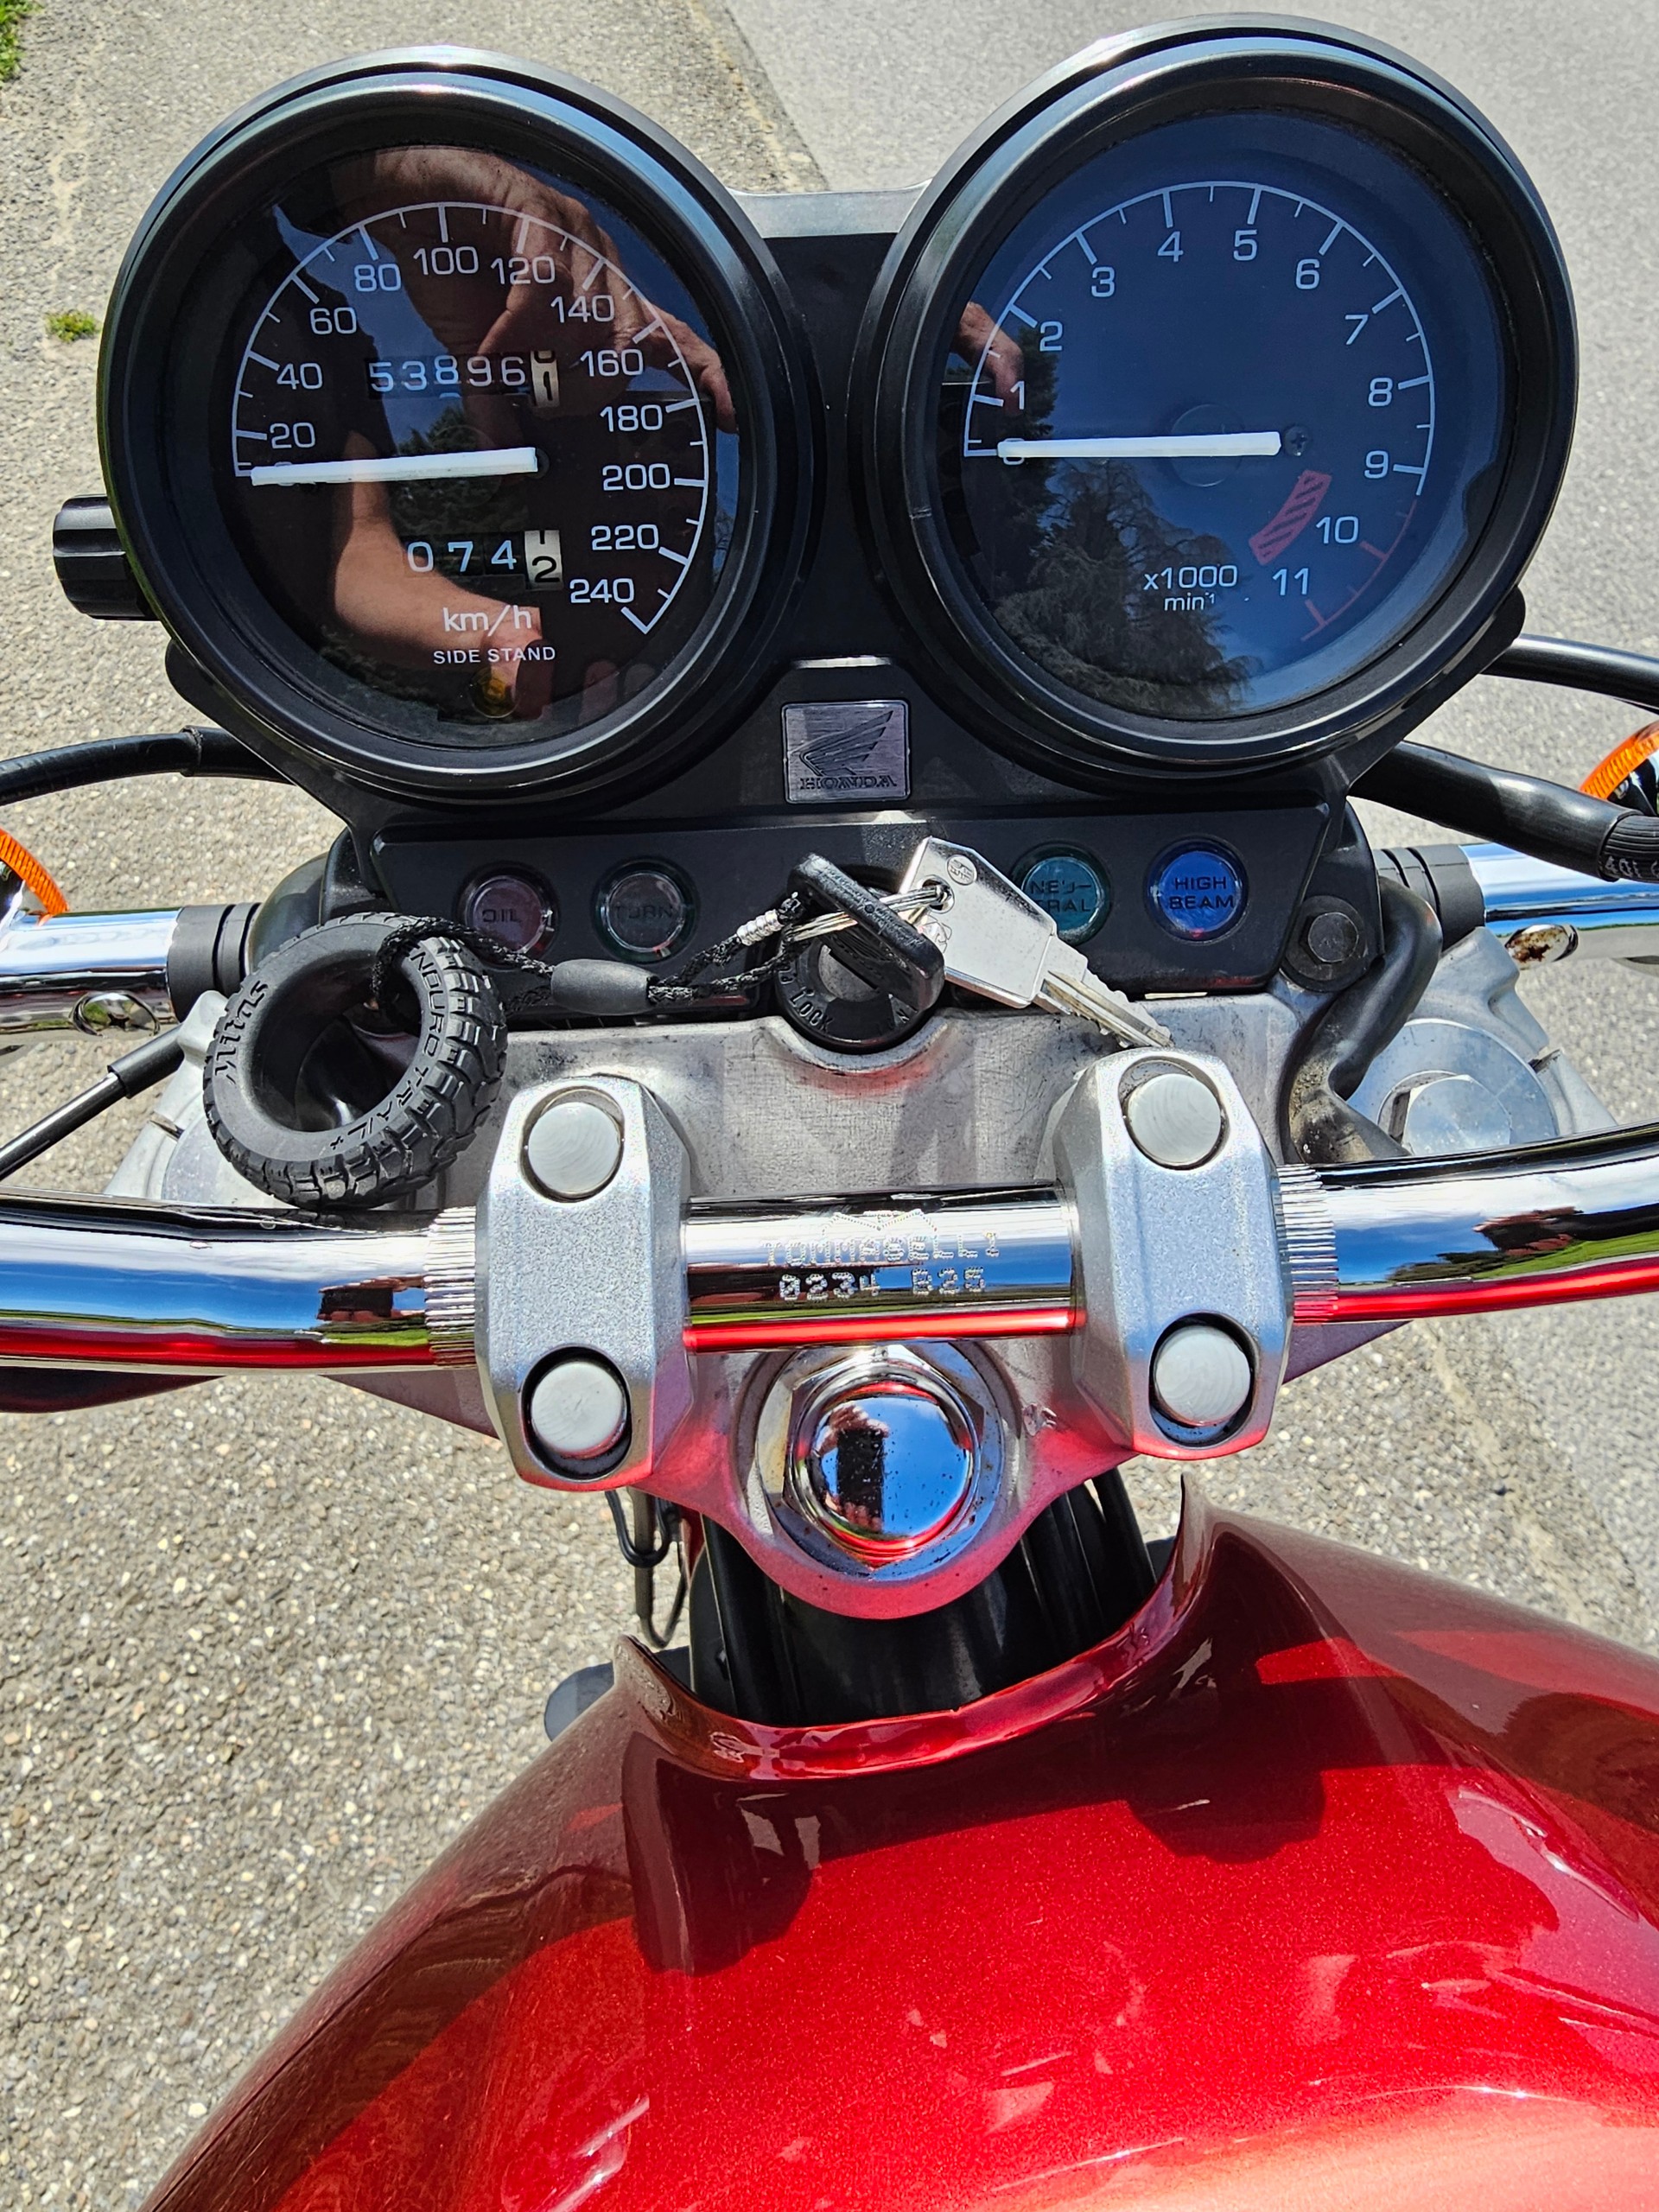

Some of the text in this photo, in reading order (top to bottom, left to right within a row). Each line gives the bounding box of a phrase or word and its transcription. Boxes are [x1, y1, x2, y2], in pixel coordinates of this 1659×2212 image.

[1157, 231, 1184, 263] 4
[1233, 229, 1258, 261] 5
[413, 245, 479, 276] 100
[490, 255, 556, 285] 120
[1295, 258, 1320, 289] 6
[353, 263, 402, 292] 80
[1090, 266, 1116, 297] 3
[309, 307, 358, 335] 60
[550, 294, 615, 324] 140
[1039, 321, 1064, 352] 2
[1344, 314, 1369, 346] 7
[276, 362, 323, 391] 40
[580, 348, 644, 378] 160
[1009, 380, 1025, 410] 1
[1368, 377, 1393, 407] 8
[600, 404, 664, 433] 180
[269, 422, 316, 449] 20
[602, 462, 671, 492] 200
[1363, 450, 1389, 480] 9
[590, 524, 659, 551] 220
[1315, 516, 1360, 544] 10
[569, 578, 635, 604] 240
[1272, 568, 1310, 596] 11
[442, 605, 532, 637] km/h
[433, 646, 556, 664] SIDE STAND
[799, 774, 898, 790] HONDA
[1173, 876, 1228, 890] HIGH
[481, 908, 523, 924] OIL
[614, 905, 674, 920] TURN
[1168, 894, 1235, 910] BEAM
[410, 951, 446, 1058] NDURO
[789, 993, 834, 1033] LOCK
